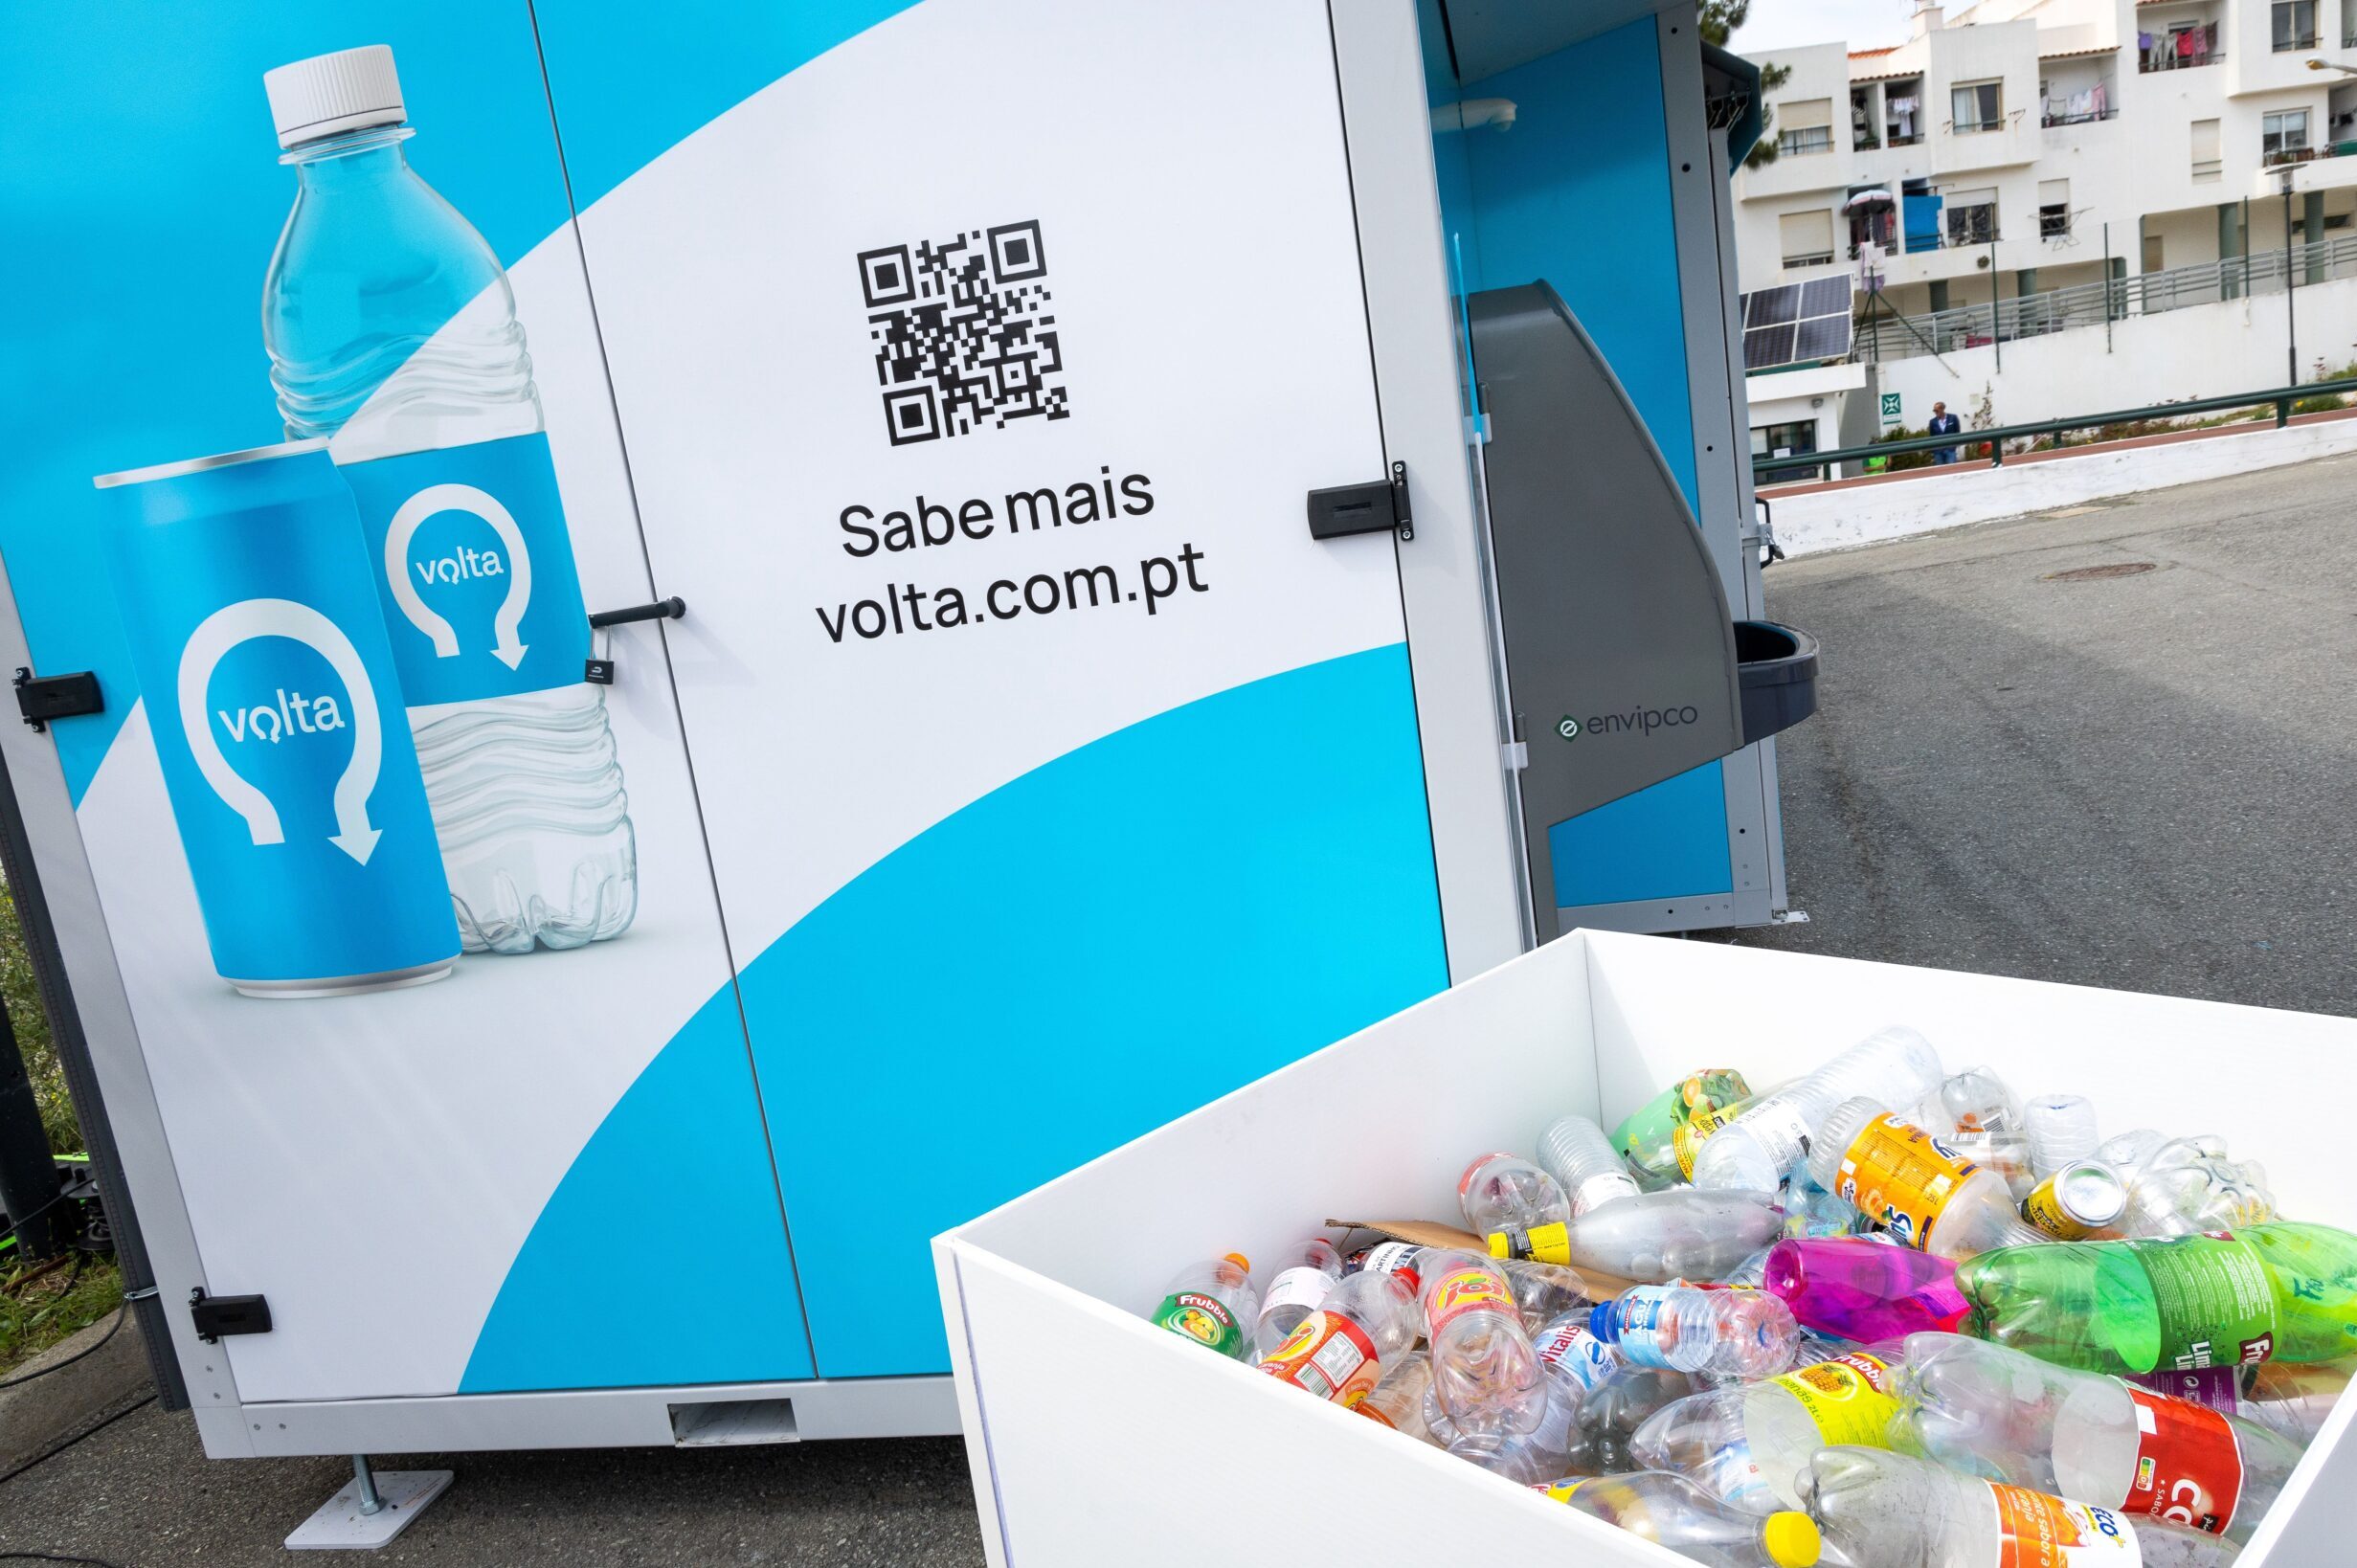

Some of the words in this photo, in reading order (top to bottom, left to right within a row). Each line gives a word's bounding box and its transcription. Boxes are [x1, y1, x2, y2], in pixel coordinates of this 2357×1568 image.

[840, 495, 995, 558] Sabe
[1005, 465, 1155, 533] mais
[415, 546, 505, 585] volta
[816, 543, 1209, 642] volta.com.pt
[218, 688, 346, 744] volta
[1586, 705, 1698, 736] envipco
[1179, 1294, 1228, 1324] Frubble
[1538, 1325, 1581, 1363] Vitalis
[2243, 1338, 2270, 1366] Fru
[1779, 1378, 1813, 1403] nanas
[2152, 1489, 2166, 1515] SABO
[2164, 1479, 2202, 1524] CO
[2037, 1518, 2053, 1556] sabor
[2089, 1506, 2119, 1536] ECO
